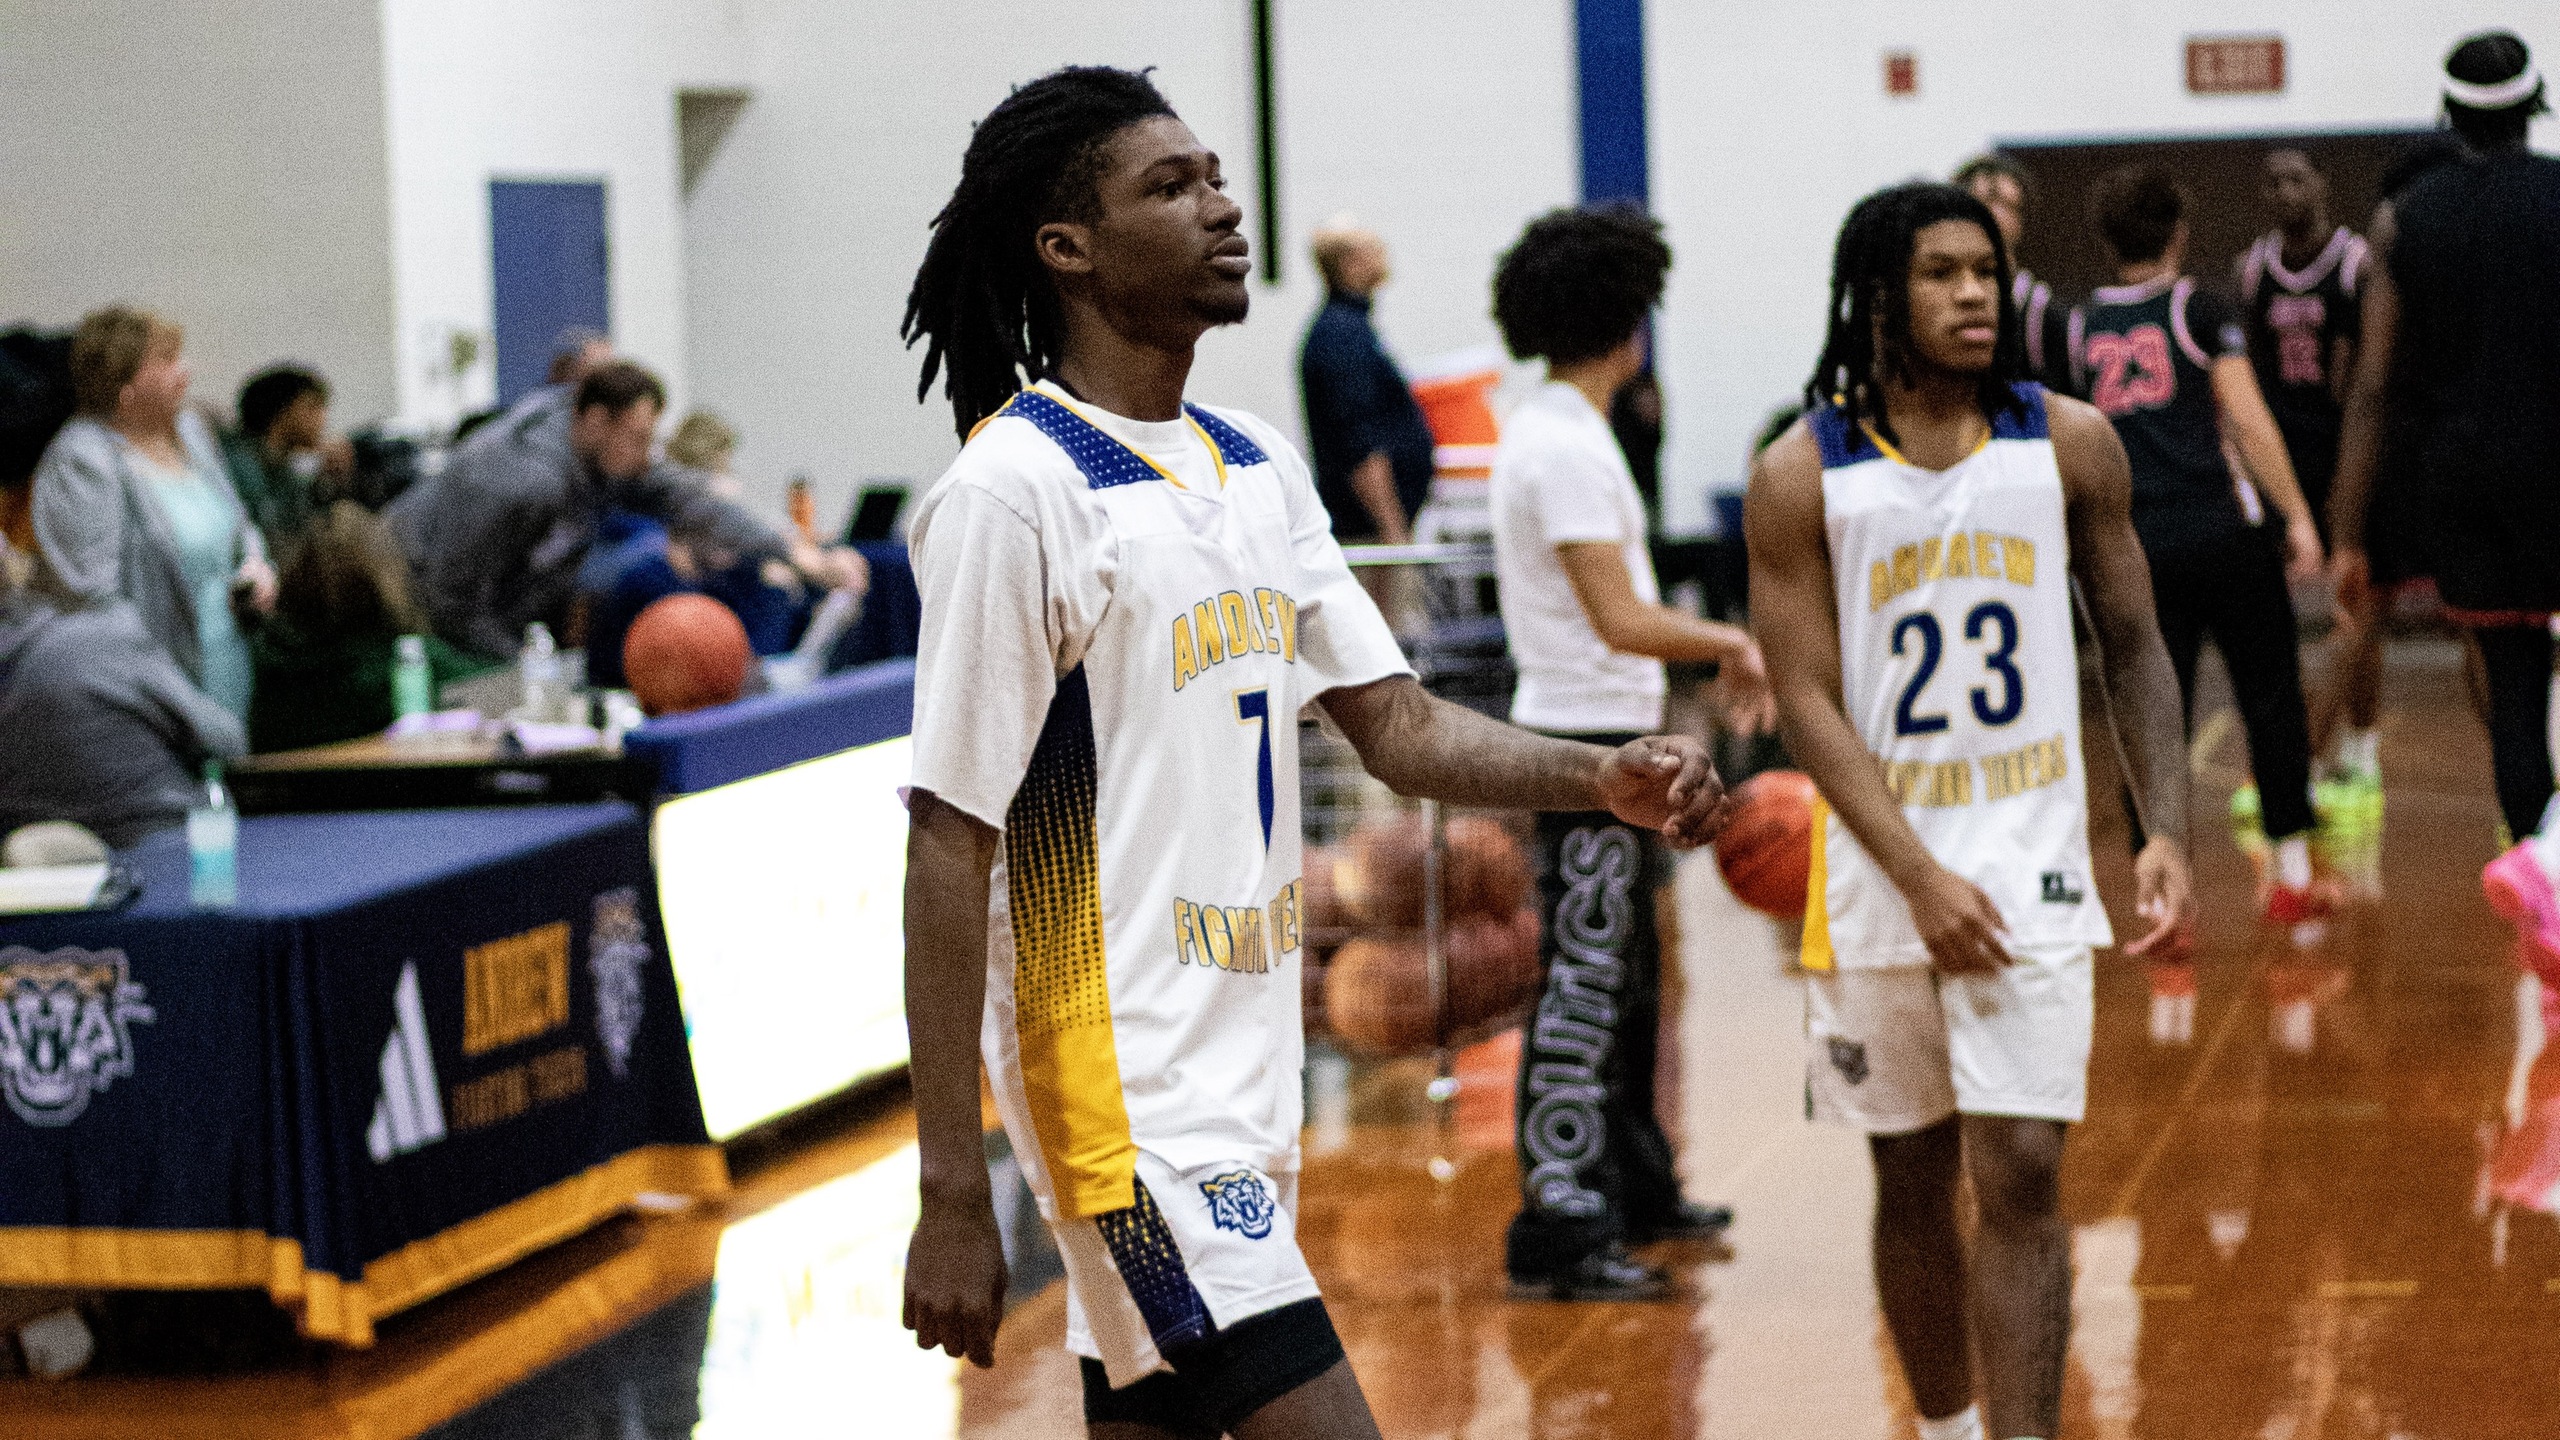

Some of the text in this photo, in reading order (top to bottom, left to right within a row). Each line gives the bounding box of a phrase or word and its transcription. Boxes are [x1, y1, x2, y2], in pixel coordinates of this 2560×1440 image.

[2086, 324, 2174, 415] 23
[1890, 599, 2027, 738] 23
[1231, 683, 1279, 857] 7
